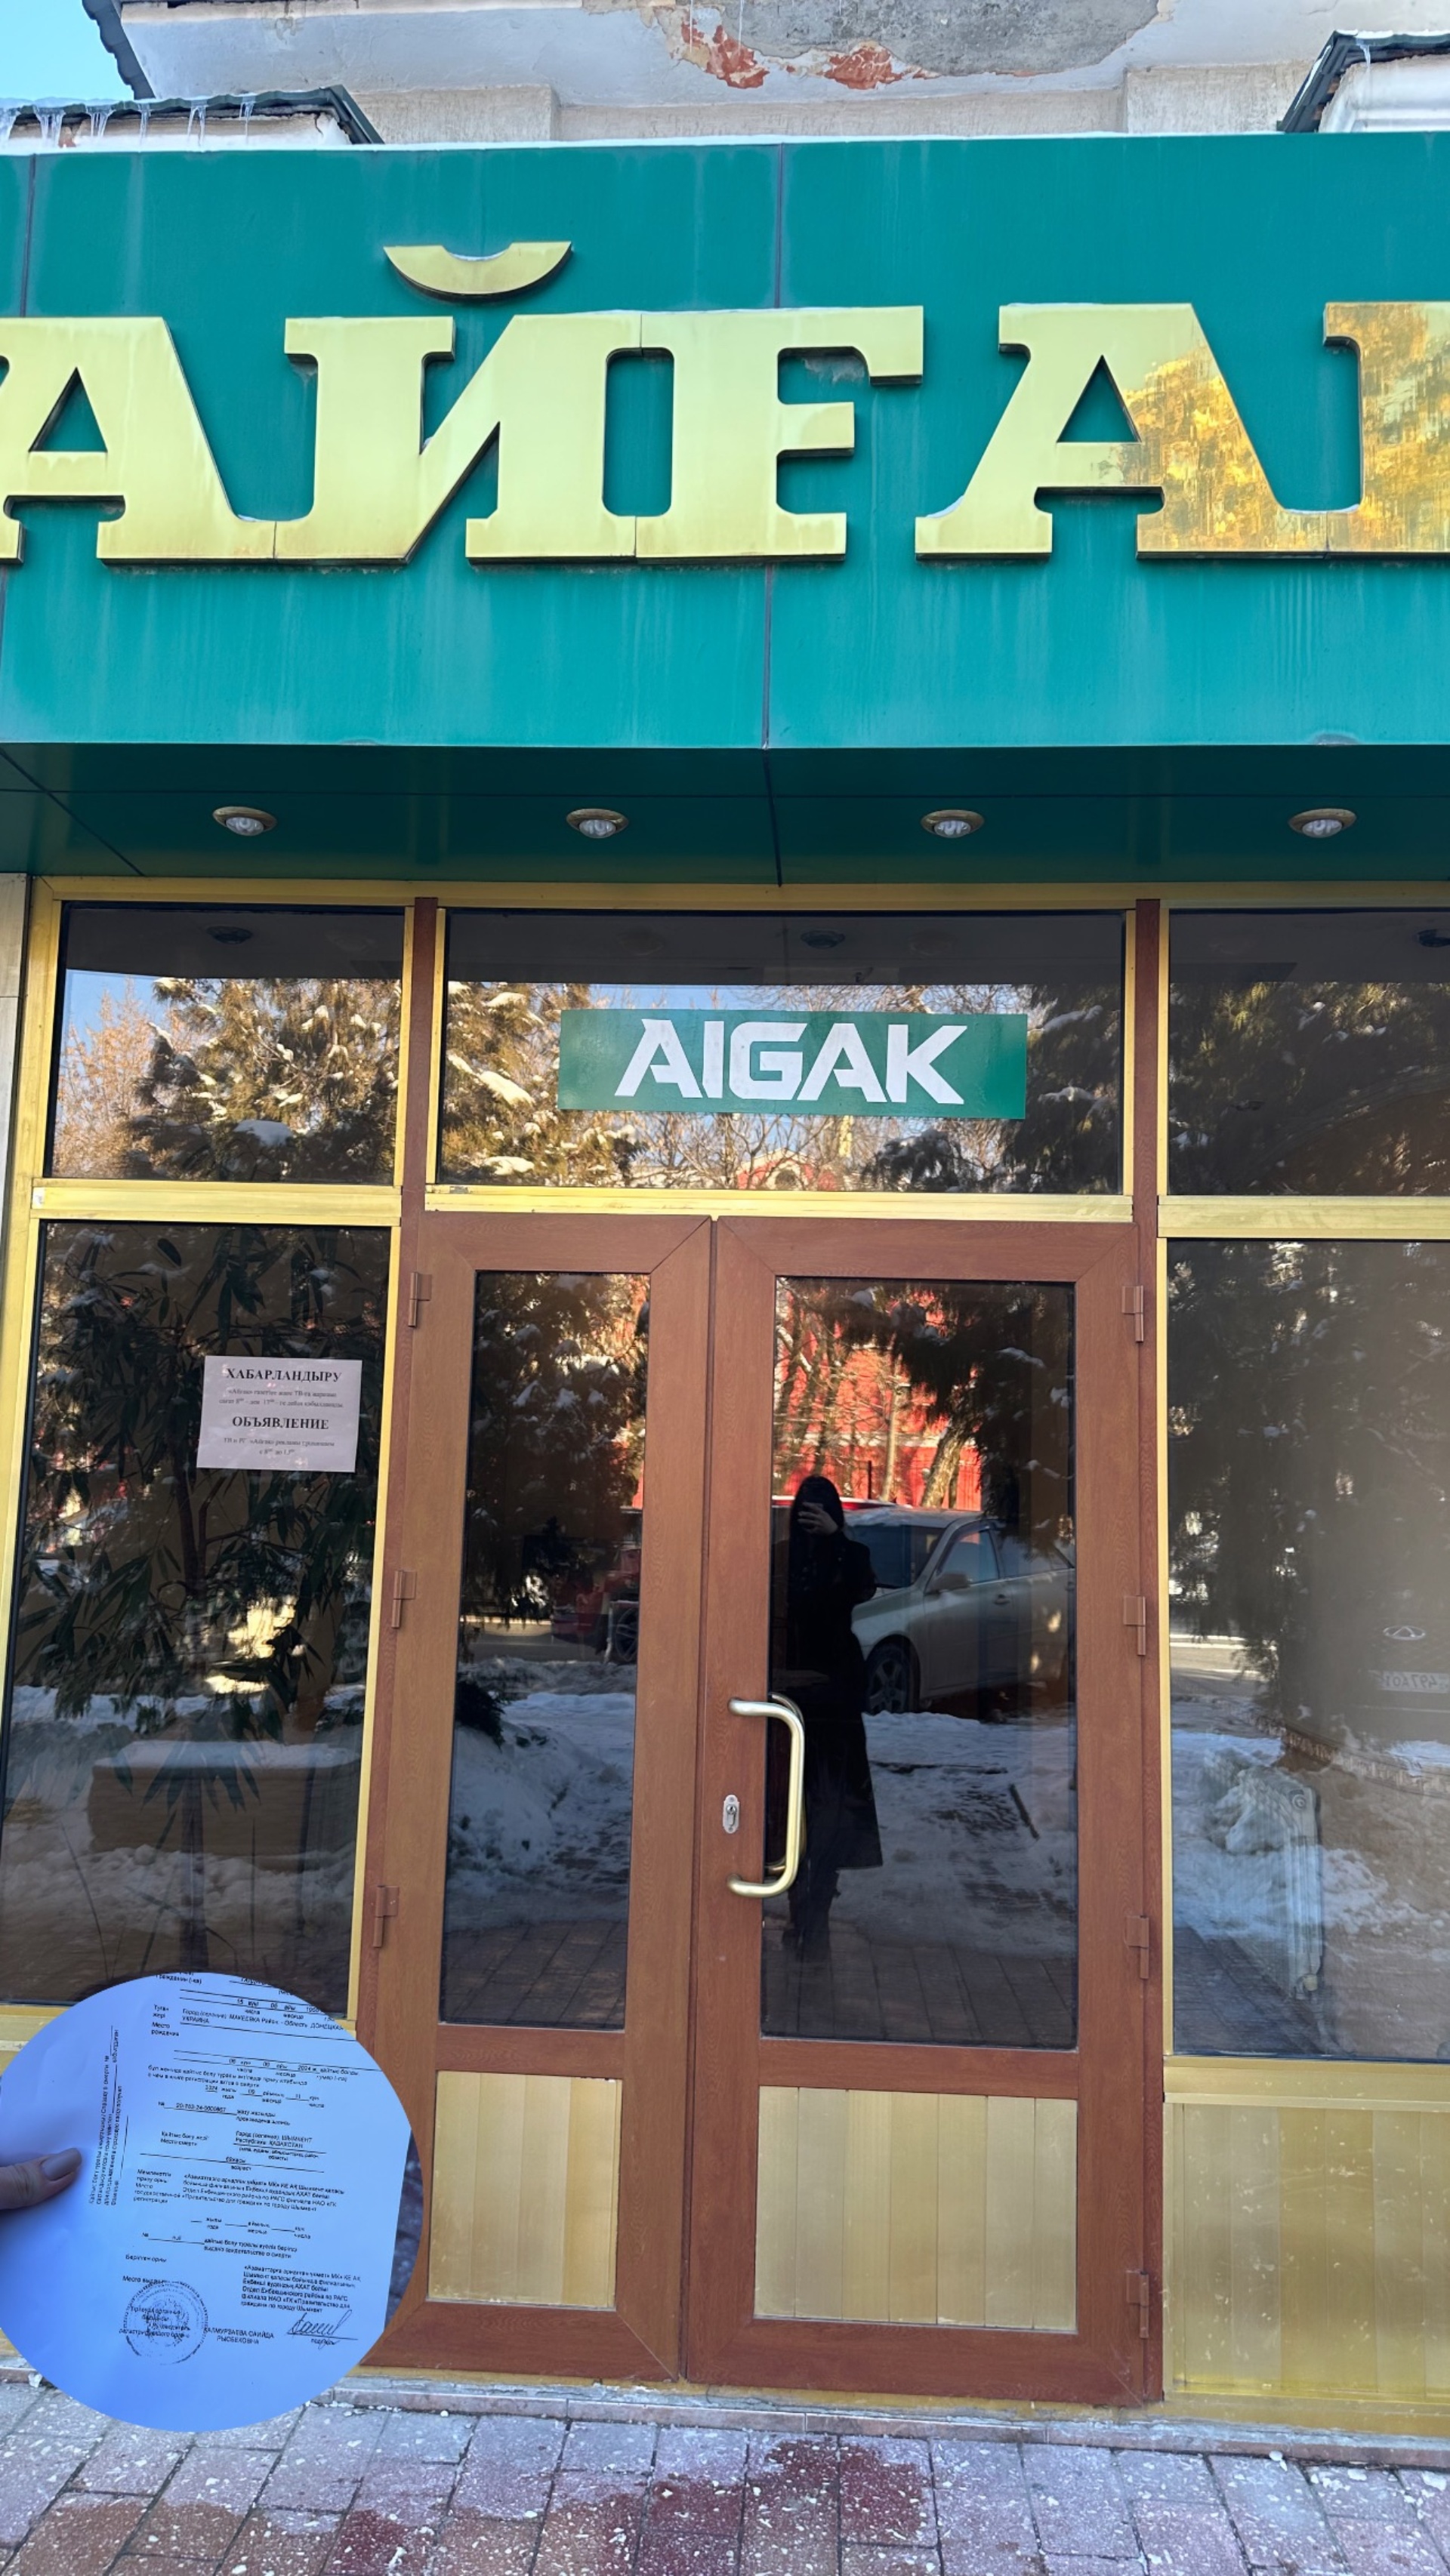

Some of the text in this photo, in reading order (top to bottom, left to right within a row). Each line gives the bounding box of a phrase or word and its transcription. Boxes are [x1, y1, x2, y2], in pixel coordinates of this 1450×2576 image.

[614, 1019, 967, 1105] AIGAK
[227, 1368, 341, 1382] ХАБАРЛАНДЫРУ
[232, 1416, 329, 1429] ОБЪЯВЛЕНИЕ
[282, 2135, 312, 2143] ШЫМКЕНТ
[134, 2190, 180, 2199] государственной
[294, 2298, 338, 2308] «Правительство
